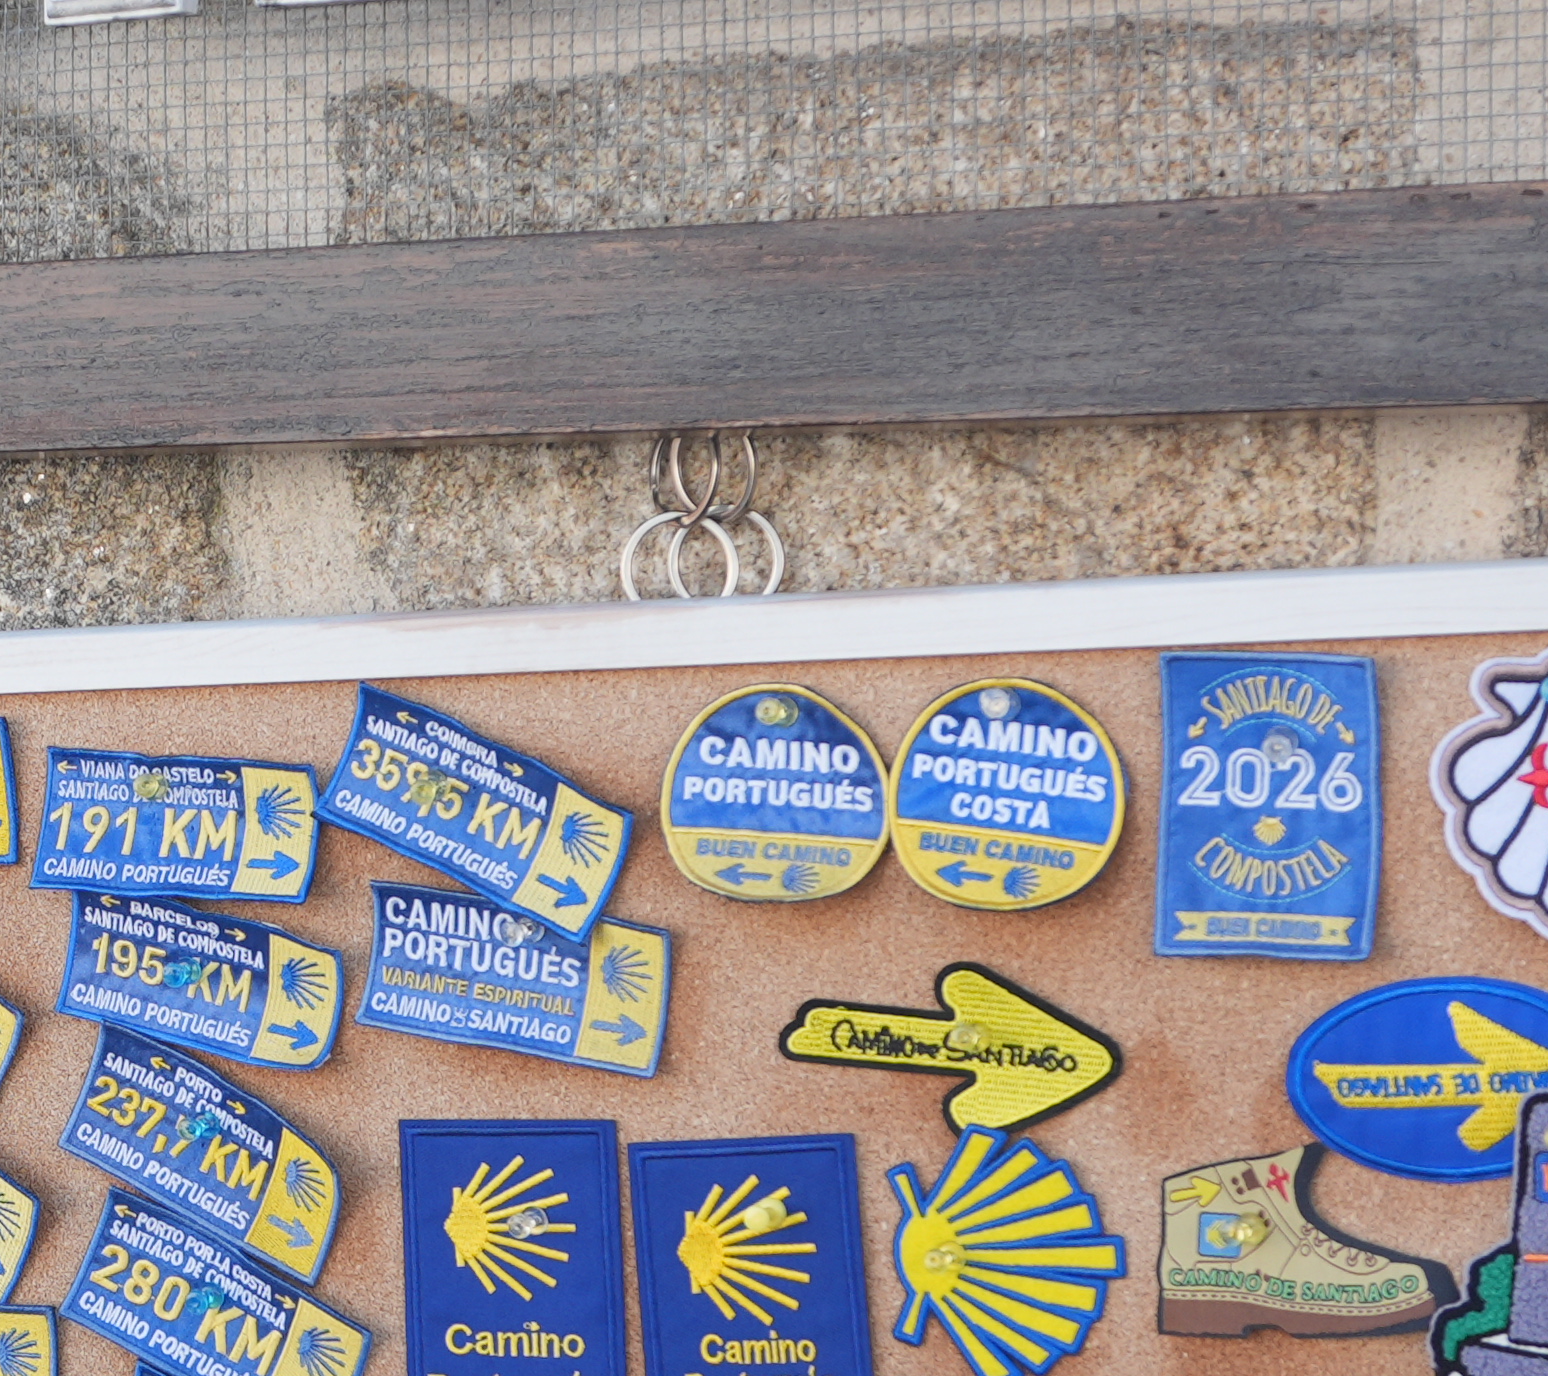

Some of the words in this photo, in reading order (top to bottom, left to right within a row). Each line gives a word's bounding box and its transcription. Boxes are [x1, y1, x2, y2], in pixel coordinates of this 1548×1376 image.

[425, 720, 499, 768] COIMBRA
[699, 735, 860, 775] CAMINO
[929, 713, 1098, 763] CAMINO
[80, 759, 124, 779] VIANA
[912, 753, 1108, 803] PORTUGUÉS
[1177, 745, 1363, 813] 2026
[683, 777, 874, 813] PORTUGUÉS
[950, 791, 1051, 830] COSTA
[50, 801, 138, 856] 191
[159, 808, 238, 862] KM
[335, 789, 407, 835] CAMINO
[406, 823, 519, 890] PORTUGUÉS
[697, 837, 758, 859] BUEN
[761, 842, 852, 868] CAMINO
[919, 831, 981, 855] BUEN
[984, 839, 1075, 871] CAMINO
[43, 857, 117, 881] CAMINO
[122, 862, 232, 887] PORTUGUÉS
[1194, 835, 1350, 896] COMPOSTELA
[130, 901, 221, 939] BARCELOS
[385, 895, 518, 944] CAMINO
[92, 932, 166, 986] 195
[186, 960, 252, 1014] KM
[383, 927, 582, 989] PORTUGUÉS
[381, 965, 468, 997] VARIANTE
[473, 981, 576, 1017] ESPIRITUAL
[70, 983, 141, 1016] CAMINO
[144, 1002, 252, 1048] PORTUGUÉS
[174, 1066, 222, 1103] PORTO
[134, 1211, 184, 1245] PORTO
[183, 1234, 213, 1262] POR
[231, 1261, 272, 1300] COSTA
[1168, 1267, 1262, 1292] CAMINO
[1267, 1276, 1297, 1301] DE
[1302, 1275, 1420, 1304] SANTIAGO
[445, 1321, 585, 1359] Camino
[700, 1330, 817, 1366] Camino
